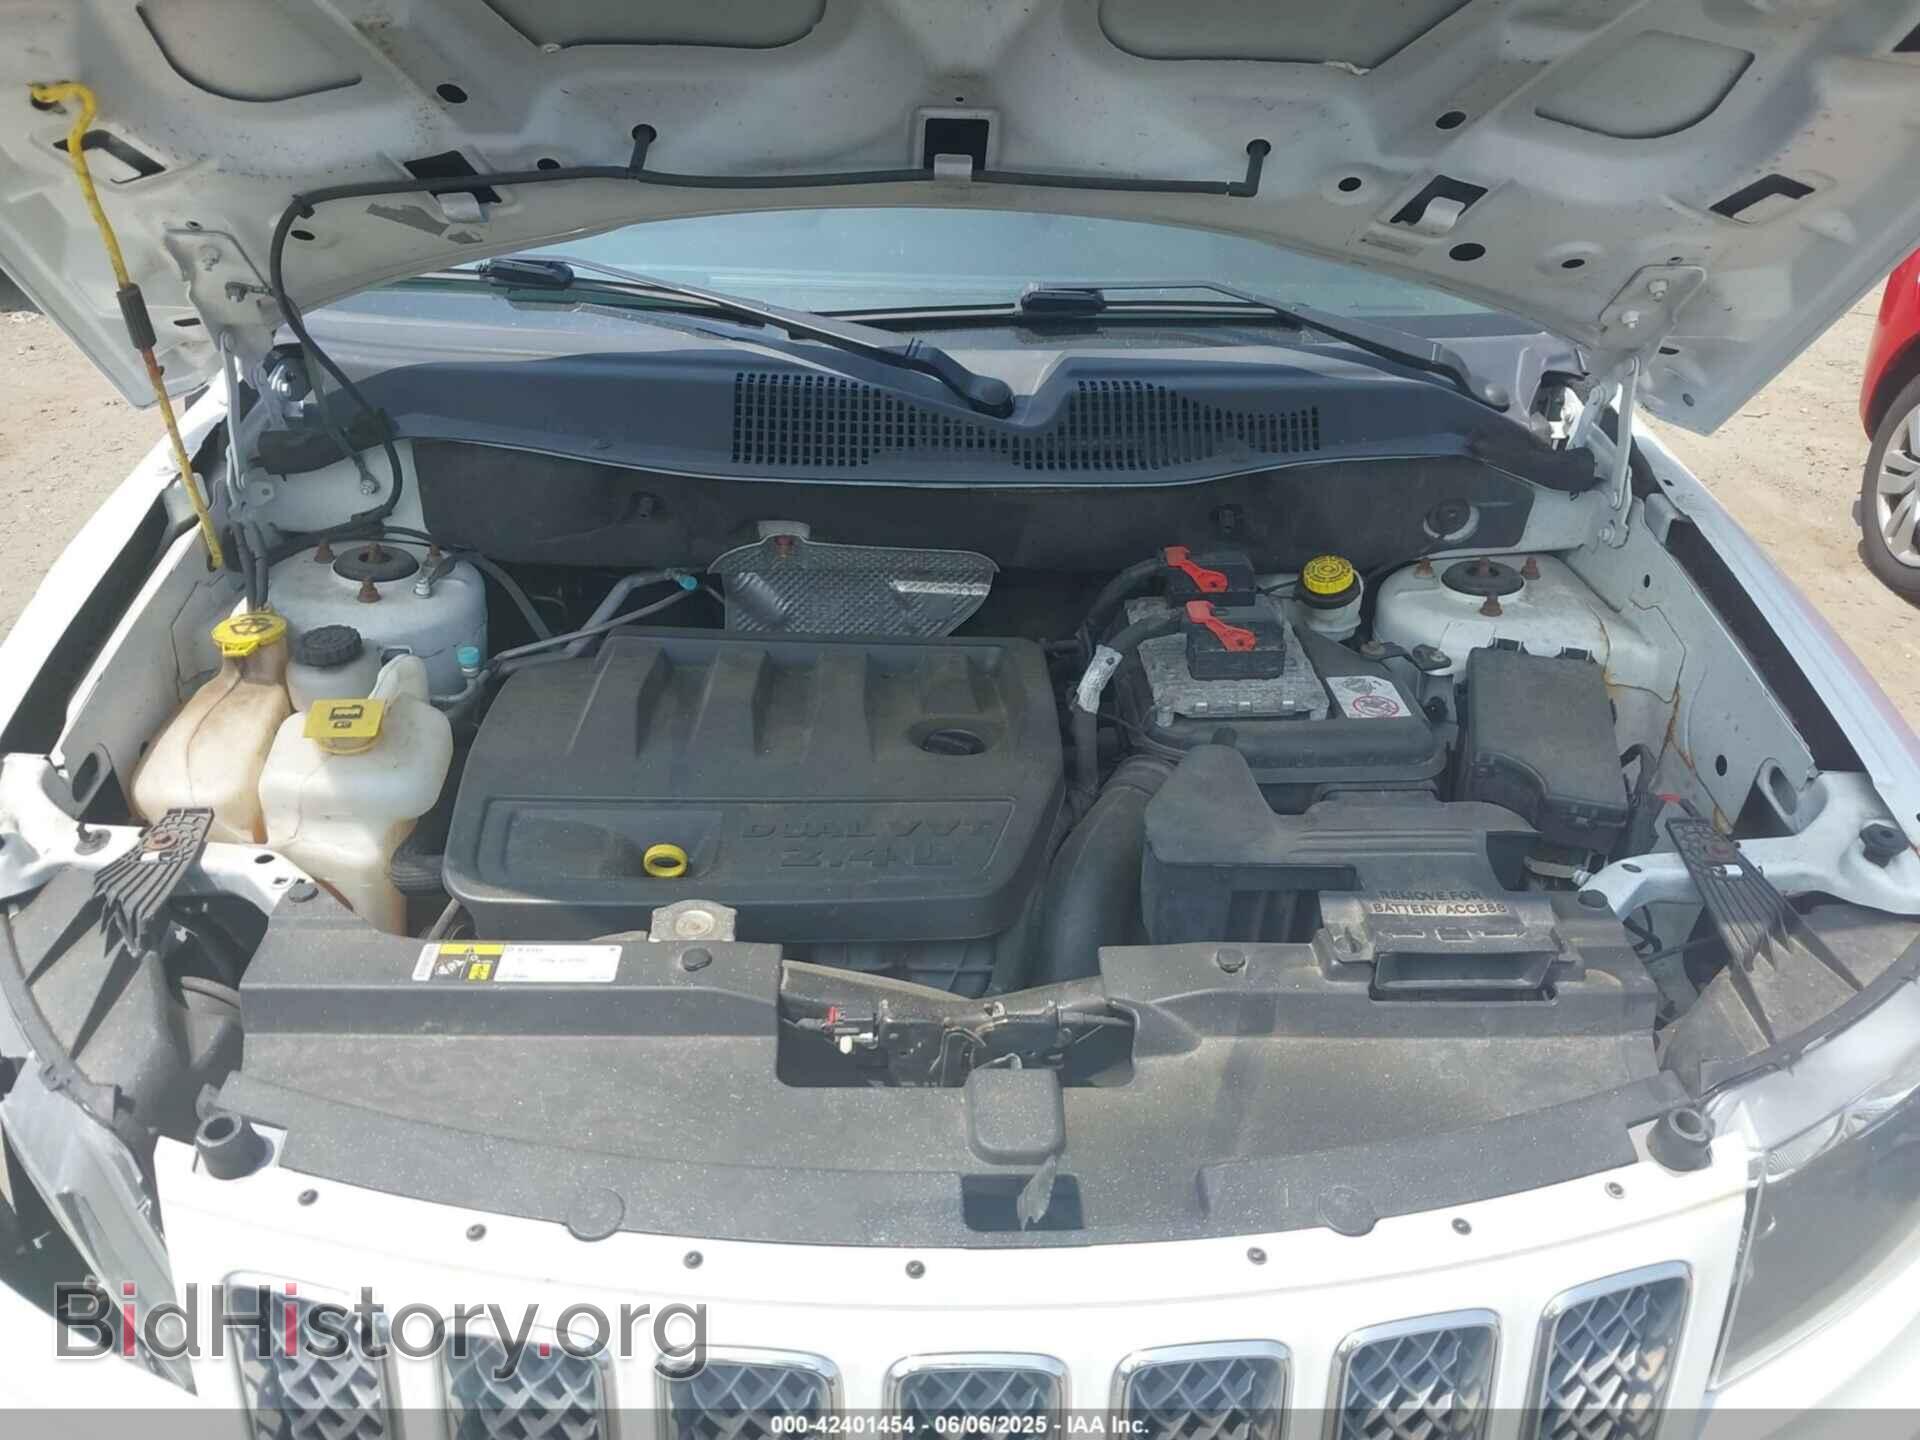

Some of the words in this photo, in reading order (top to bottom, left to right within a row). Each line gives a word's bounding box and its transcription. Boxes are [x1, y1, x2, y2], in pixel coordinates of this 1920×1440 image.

[1379, 889, 1447, 901] REMOVE
[1449, 890, 1482, 901] FOR
[1373, 903, 1440, 914] BATTERY
[1445, 903, 1507, 915] ACCESS
